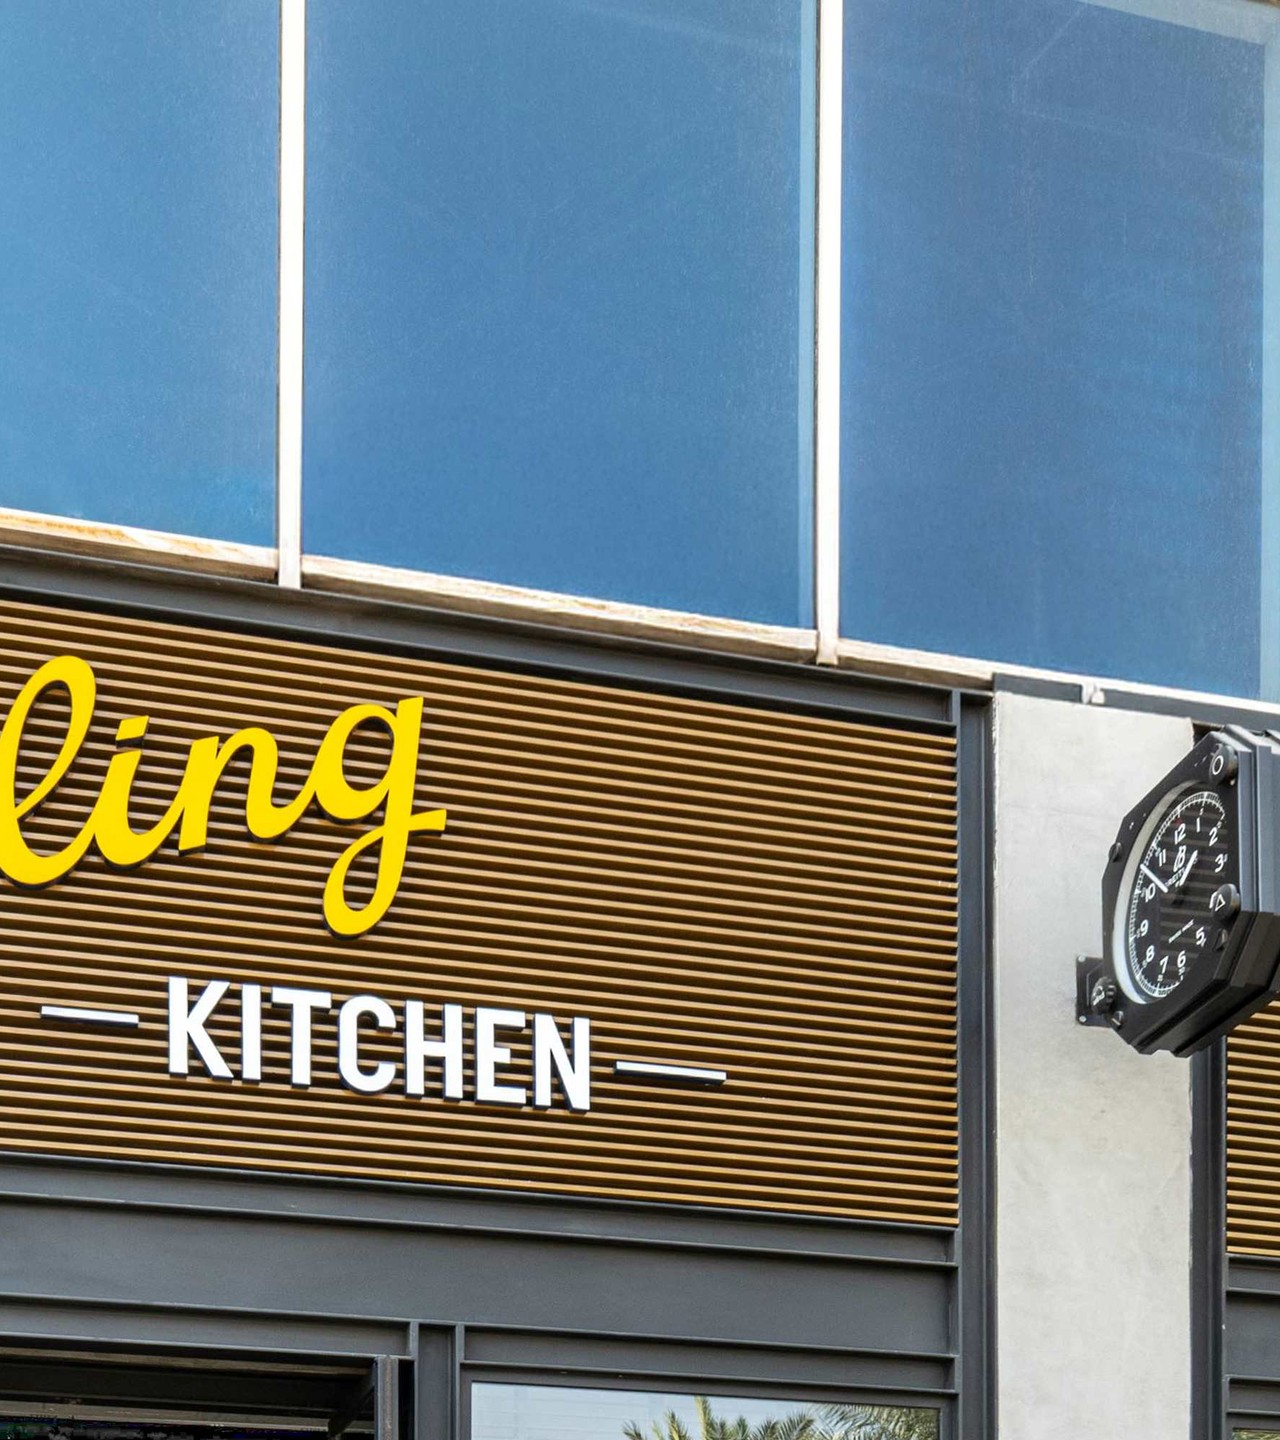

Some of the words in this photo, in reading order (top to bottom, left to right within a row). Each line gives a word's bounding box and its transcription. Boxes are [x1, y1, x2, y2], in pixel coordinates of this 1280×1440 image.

[1174, 823, 1186, 845] 12
[1209, 827, 1219, 846] 2
[1215, 854, 1224, 873] 3
[1145, 883, 1156, 902] 10
[1140, 920, 1149, 937] 9
[1195, 927, 1205, 946] 5
[1146, 945, 1155, 963] 8
[1177, 950, 1186, 967] 6
[1160, 955, 1169, 973] 7
[167, 976, 592, 1112] KITCHEN
